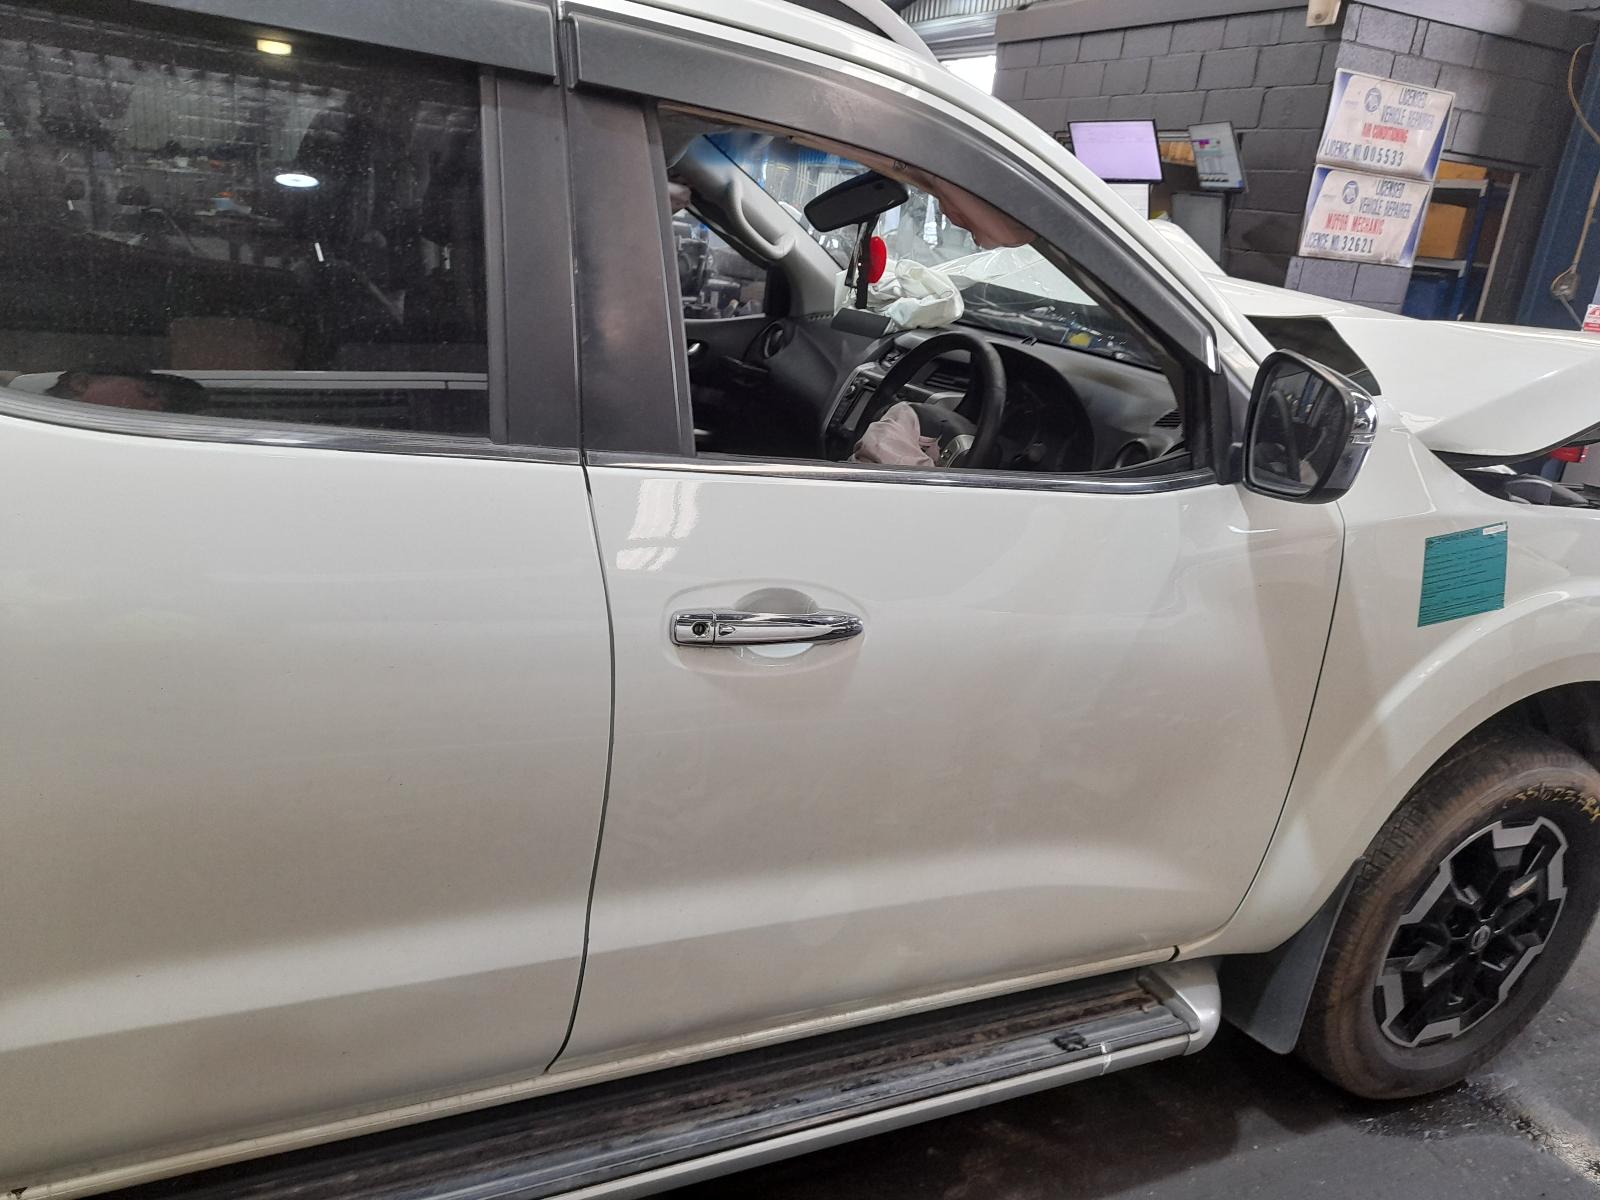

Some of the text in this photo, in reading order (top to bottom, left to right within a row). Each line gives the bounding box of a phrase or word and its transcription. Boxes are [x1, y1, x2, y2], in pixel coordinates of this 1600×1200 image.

[1382, 105, 1407, 124] VEHICLE
[1363, 146, 1404, 167] 005533
[1358, 199, 1413, 218] VEHICLE REPAIRER
[1325, 212, 1385, 235] MOTOR MECHANIC
[1341, 236, 1374, 252] 32621
